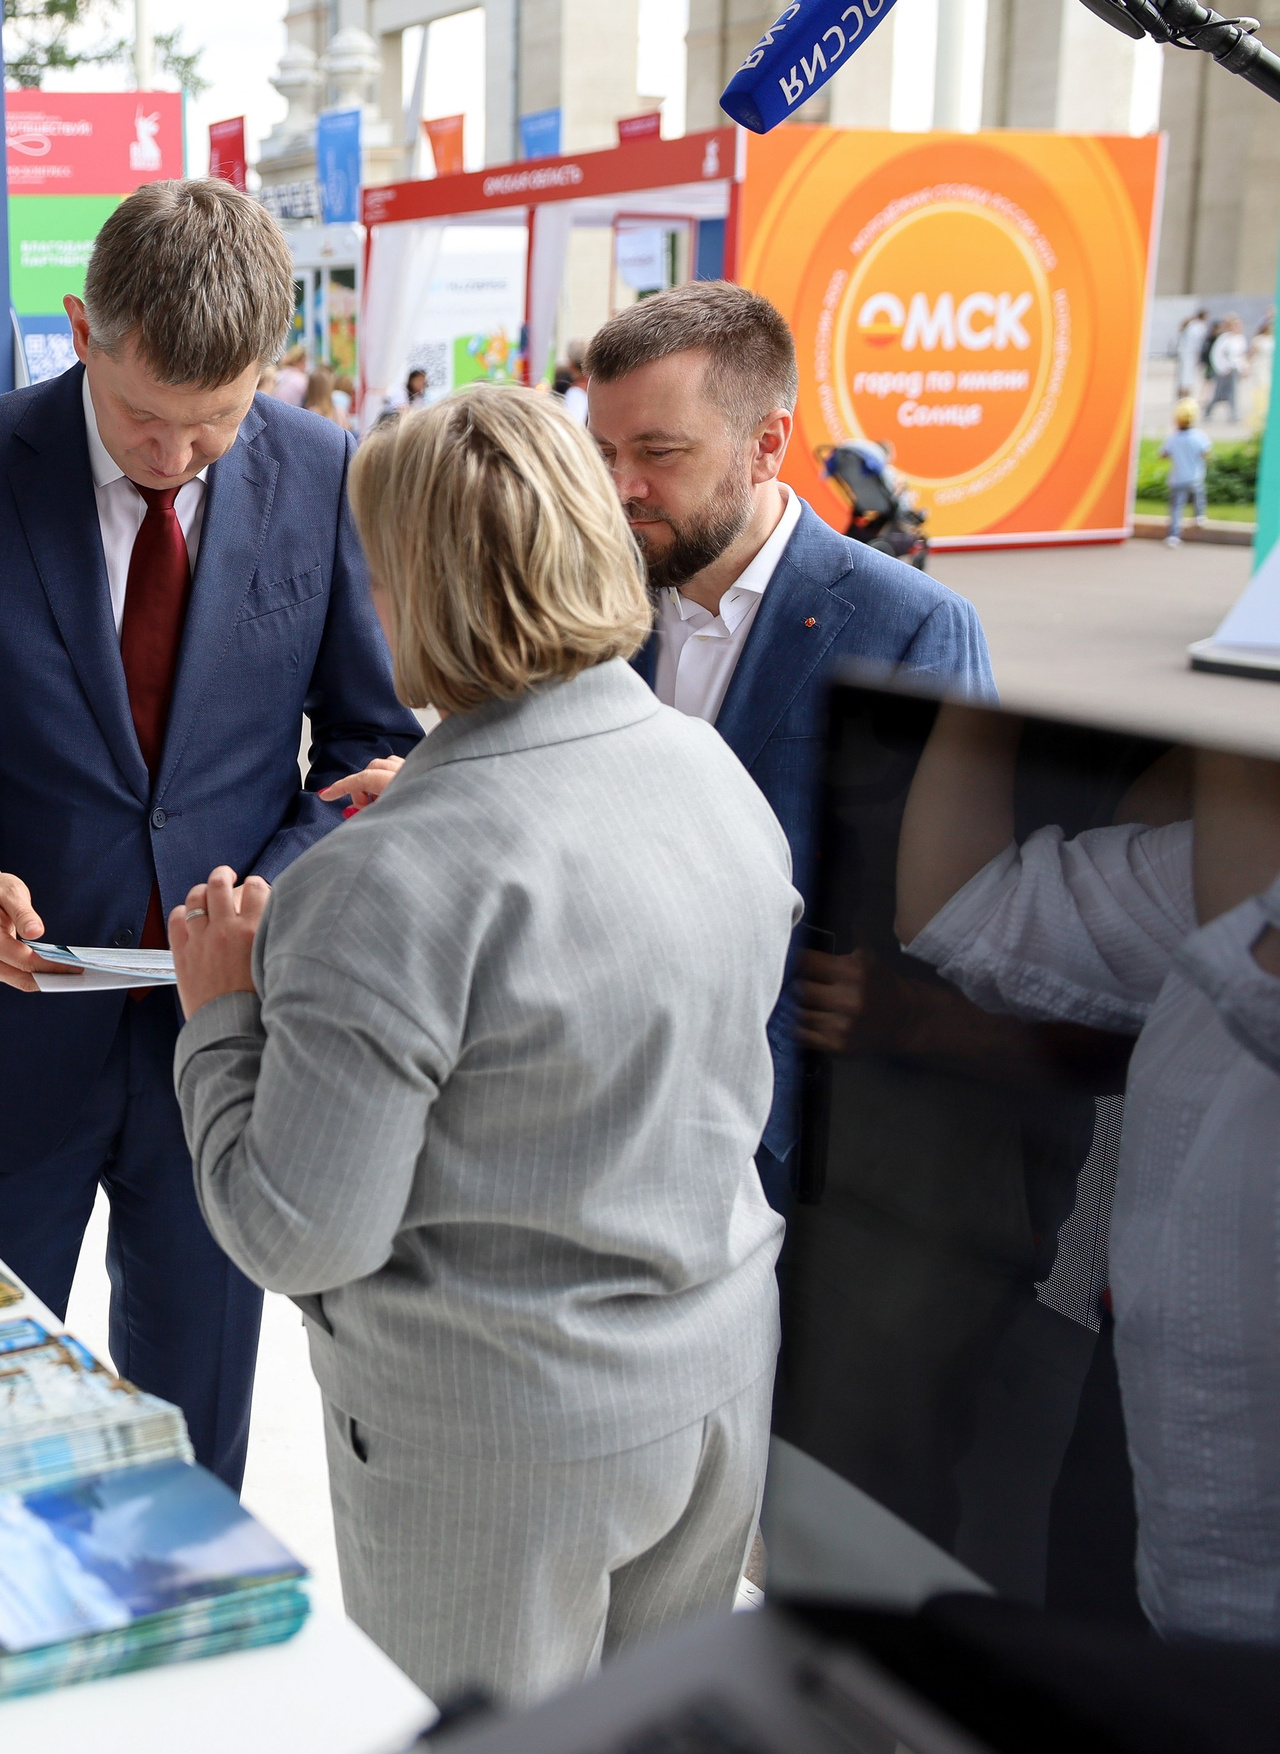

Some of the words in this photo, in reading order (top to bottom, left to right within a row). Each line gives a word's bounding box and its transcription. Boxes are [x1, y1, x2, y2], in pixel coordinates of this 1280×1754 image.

[857, 291, 1034, 352] ОМСК
[853, 371, 924, 400] город
[924, 370, 956, 393] по
[956, 369, 1030, 392] имени
[896, 400, 983, 429] Солнце
